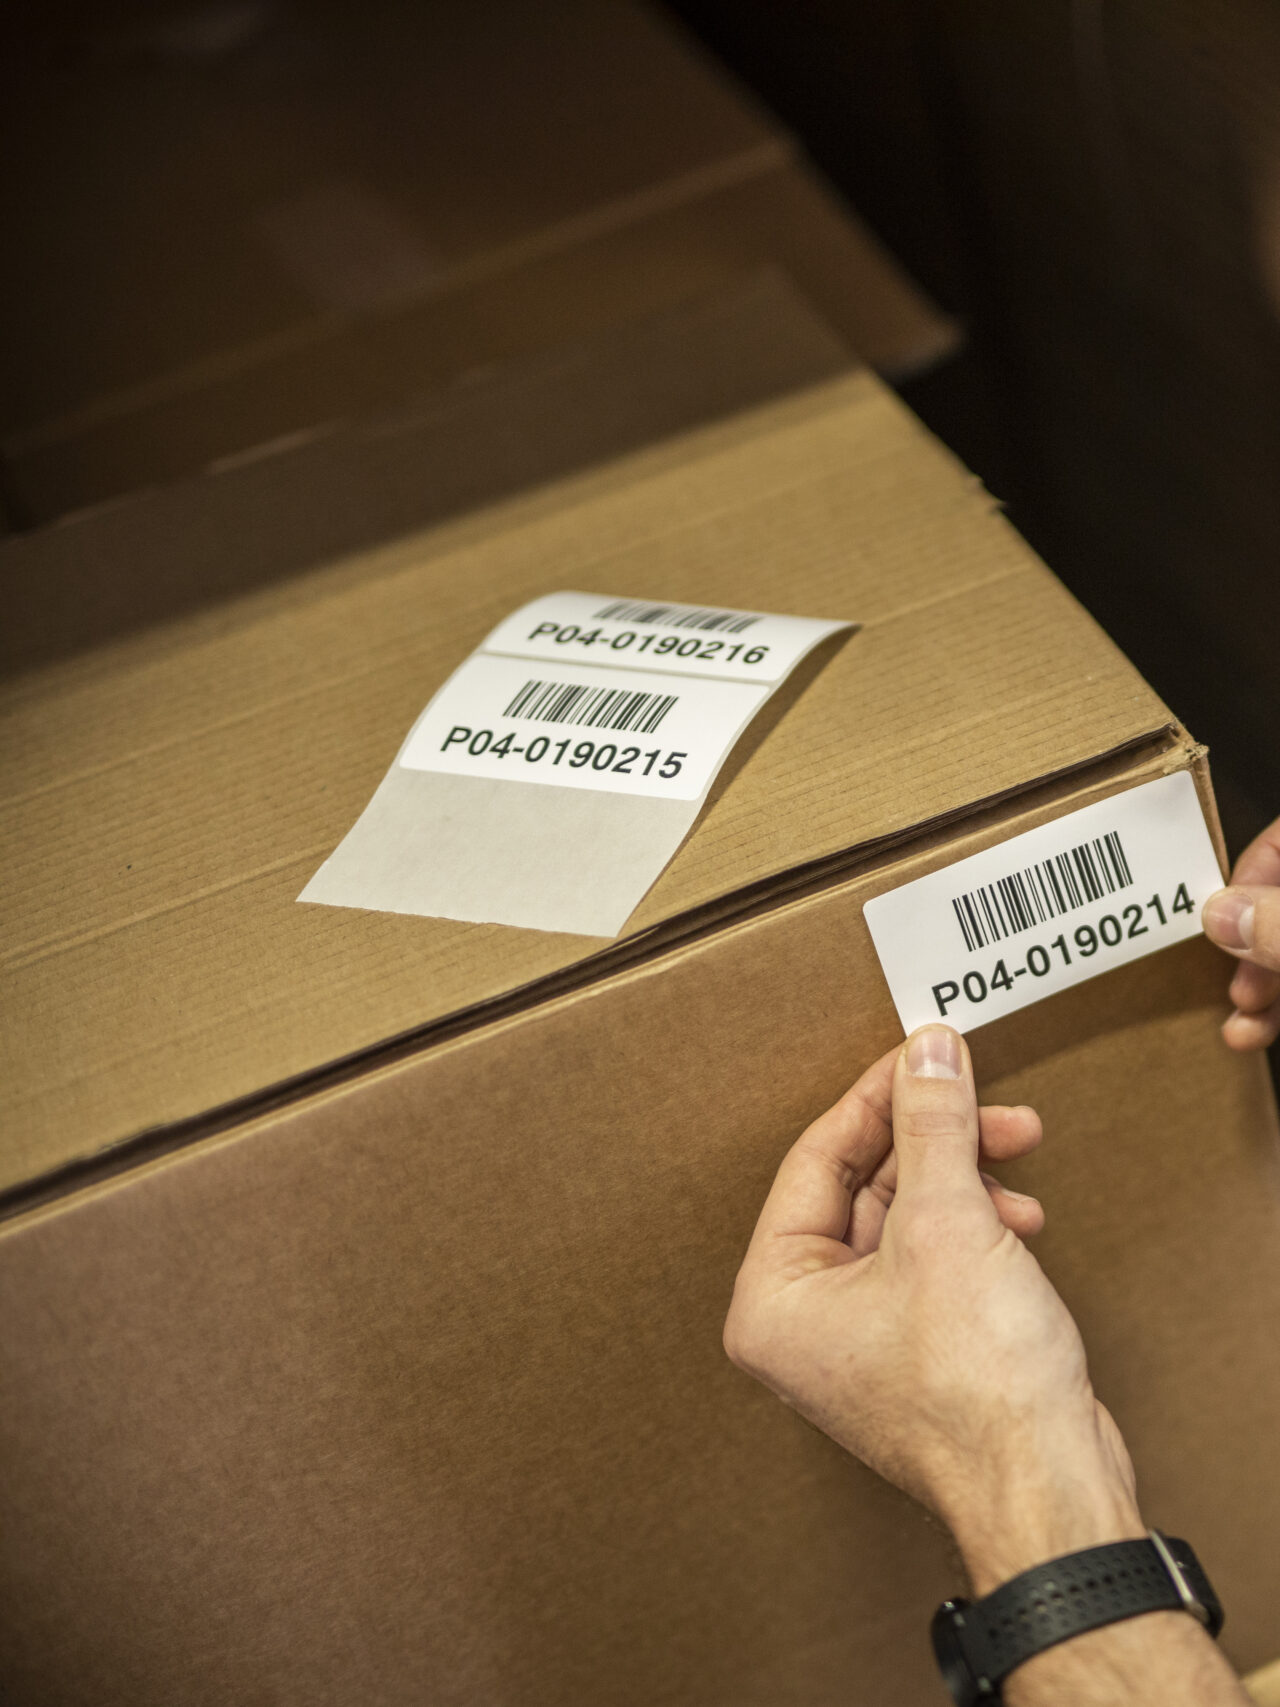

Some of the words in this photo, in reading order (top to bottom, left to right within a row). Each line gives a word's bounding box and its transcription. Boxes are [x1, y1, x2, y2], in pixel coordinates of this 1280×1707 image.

[527, 622, 770, 665] P04-0190216
[440, 726, 688, 779] P04-0190215
[931, 882, 1195, 1017] P04-0190214
